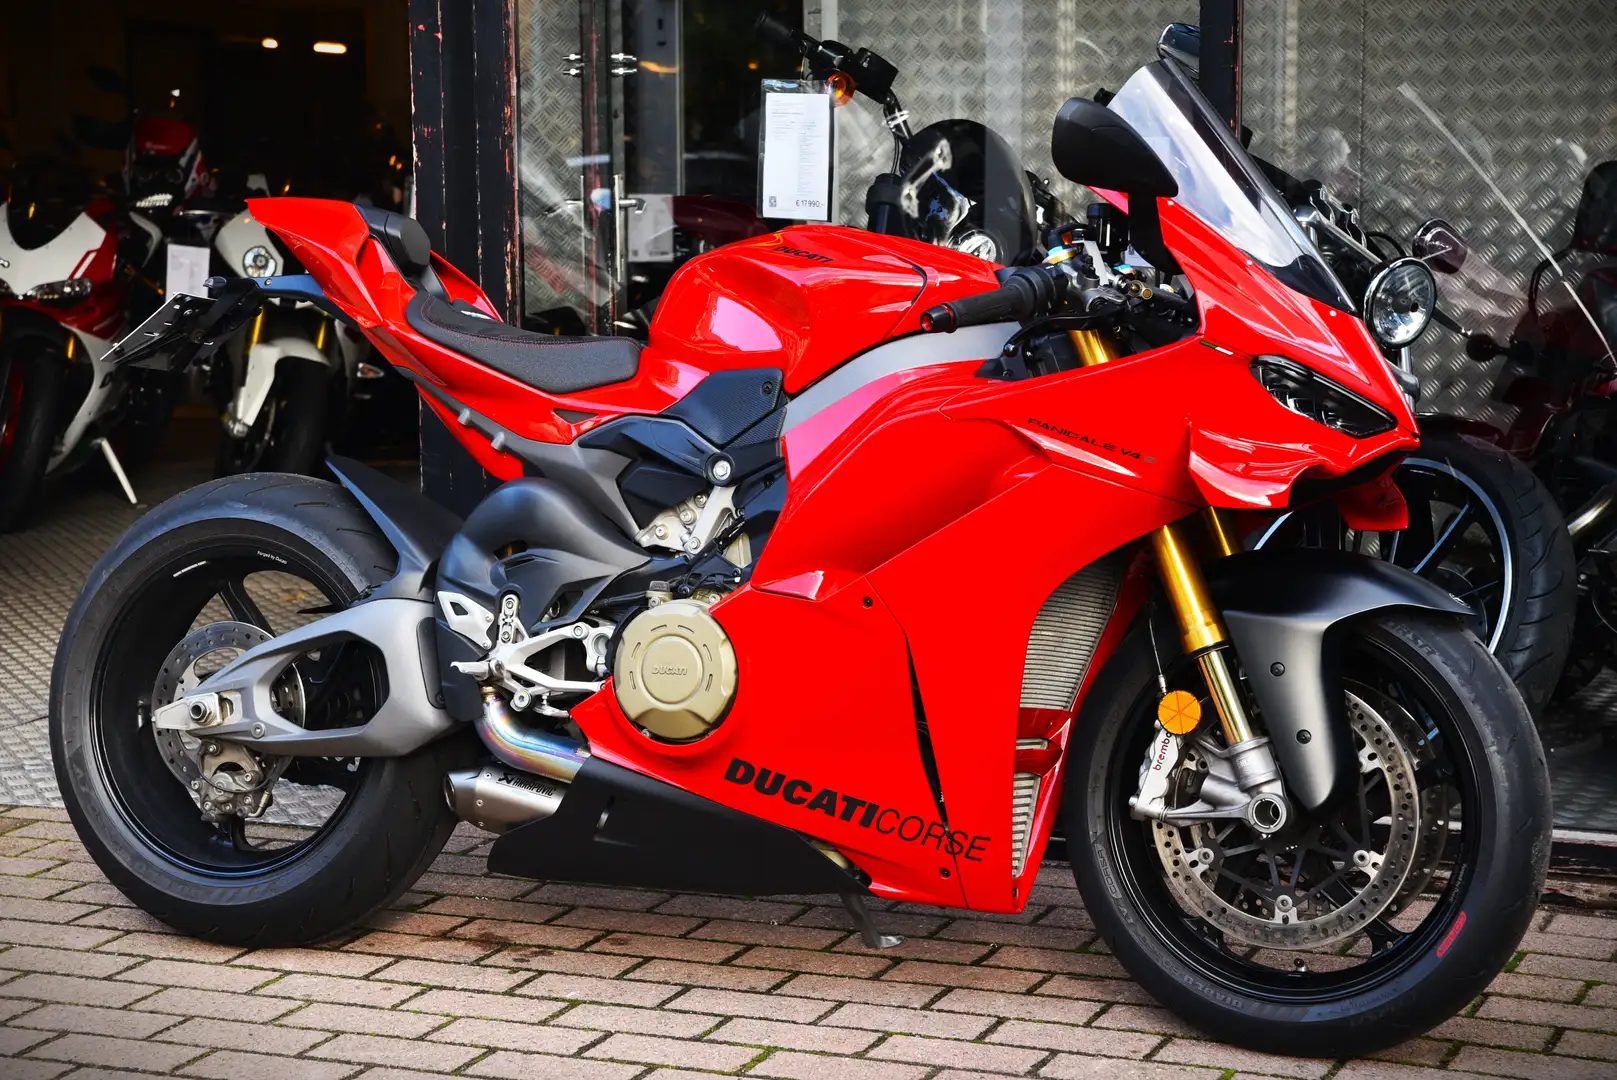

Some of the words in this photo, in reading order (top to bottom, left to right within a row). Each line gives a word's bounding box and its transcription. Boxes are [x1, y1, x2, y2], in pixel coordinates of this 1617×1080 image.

[773, 246, 833, 263] DUCATI
[1121, 448, 1141, 460] V4
[651, 665, 688, 676] DUCATI
[1097, 848, 1118, 897] CORSA
